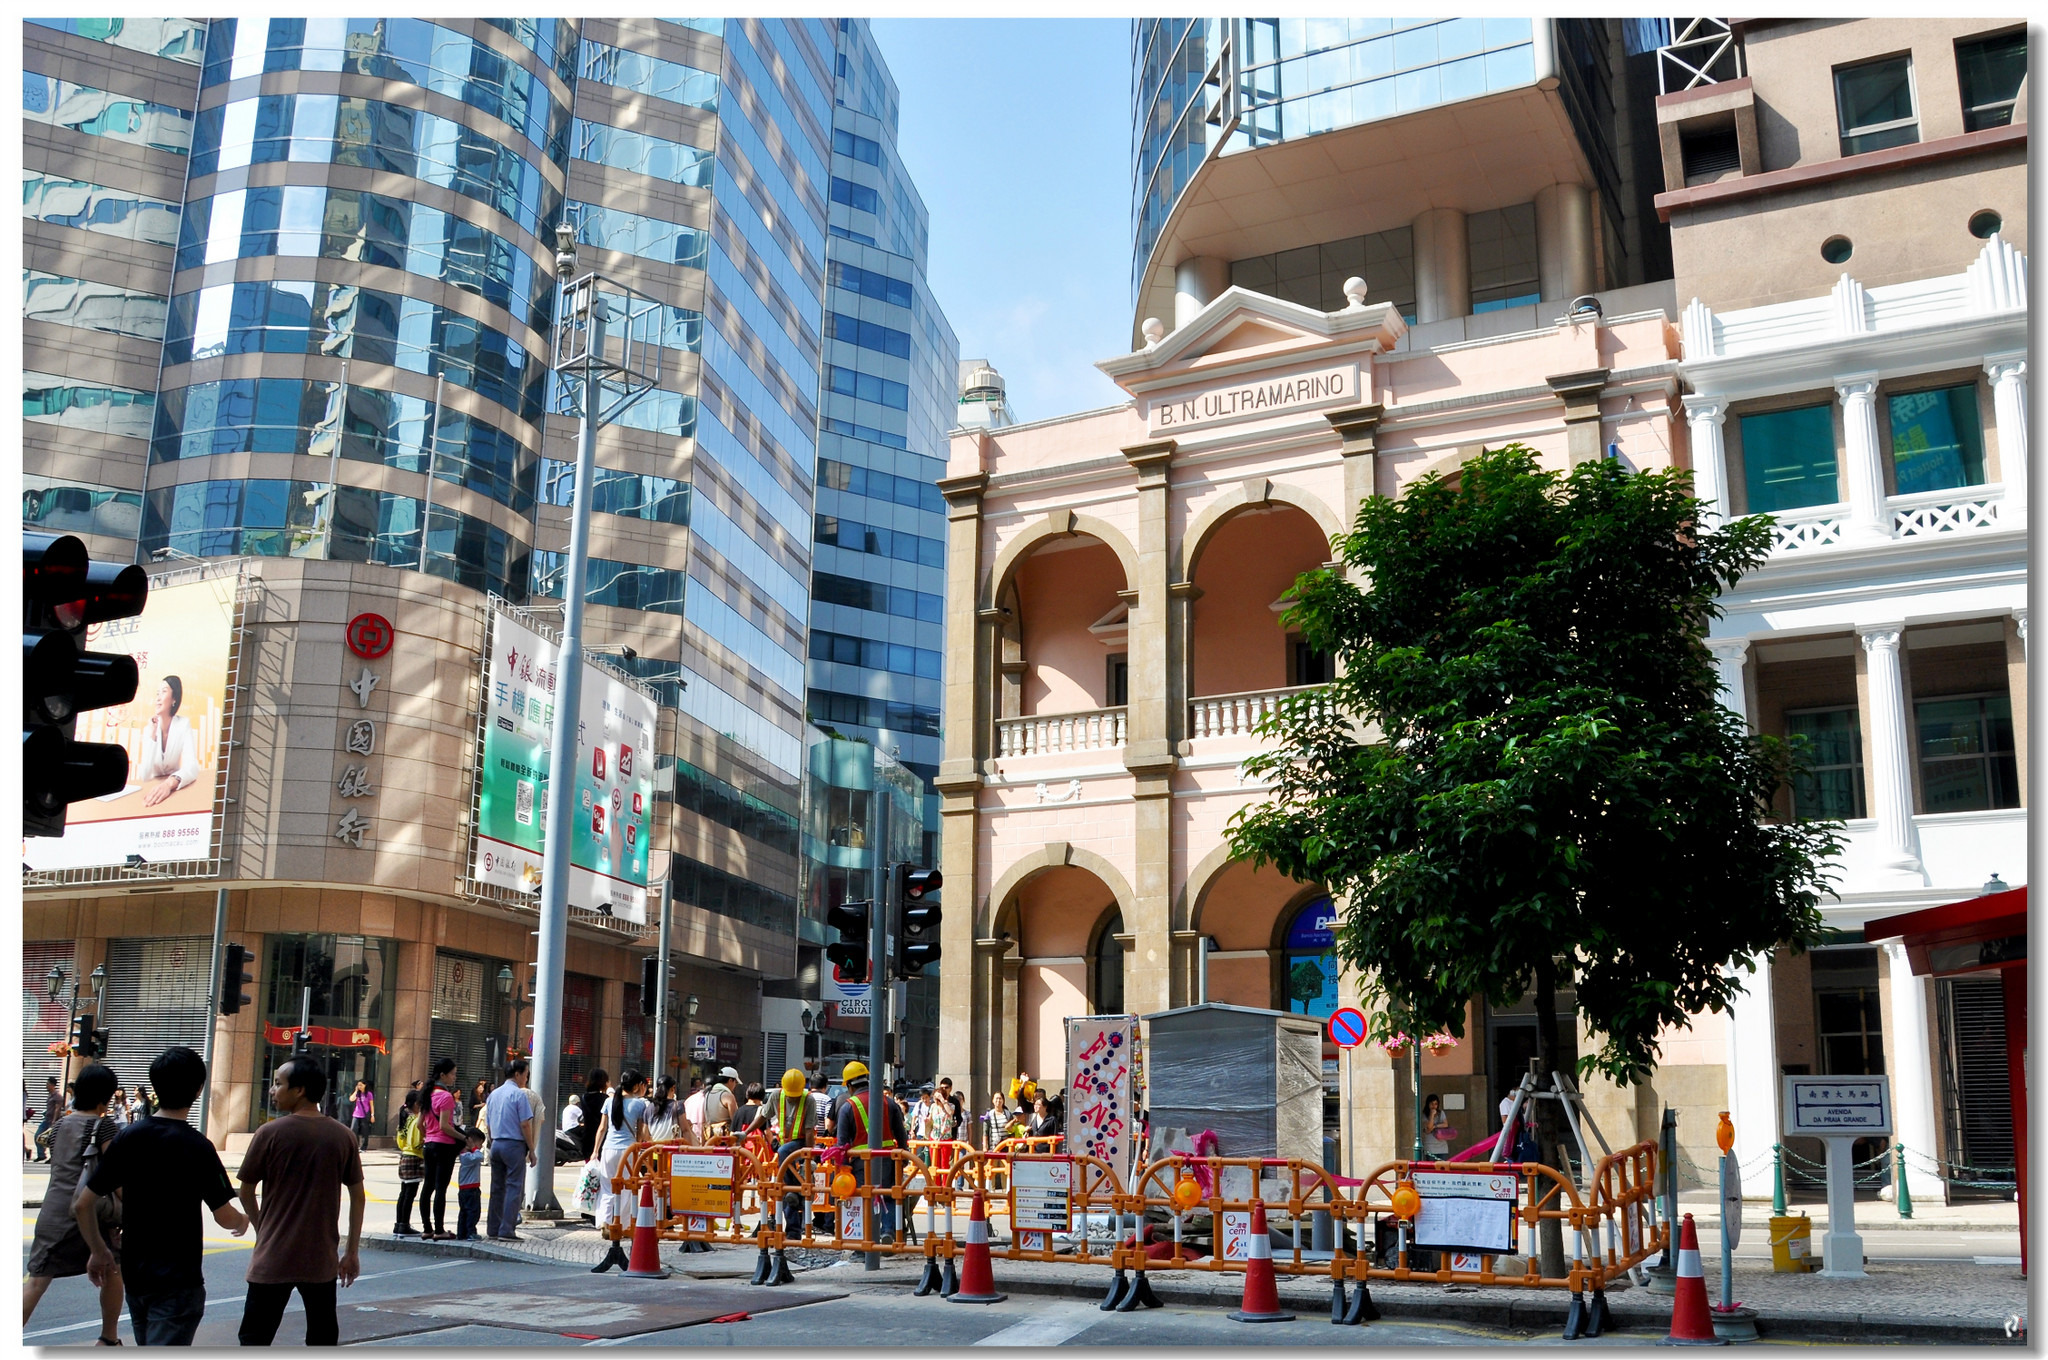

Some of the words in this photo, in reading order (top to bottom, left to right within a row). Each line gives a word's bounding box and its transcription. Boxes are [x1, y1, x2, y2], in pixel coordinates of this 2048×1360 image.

[1204, 373, 1344, 417] ULTRAMARINO
[335, 667, 382, 848] 中國銀行
[162, 829, 176, 838] 888
[177, 827, 200, 837] 95566
[1809, 1089, 1869, 1099] 南灣大馬路
